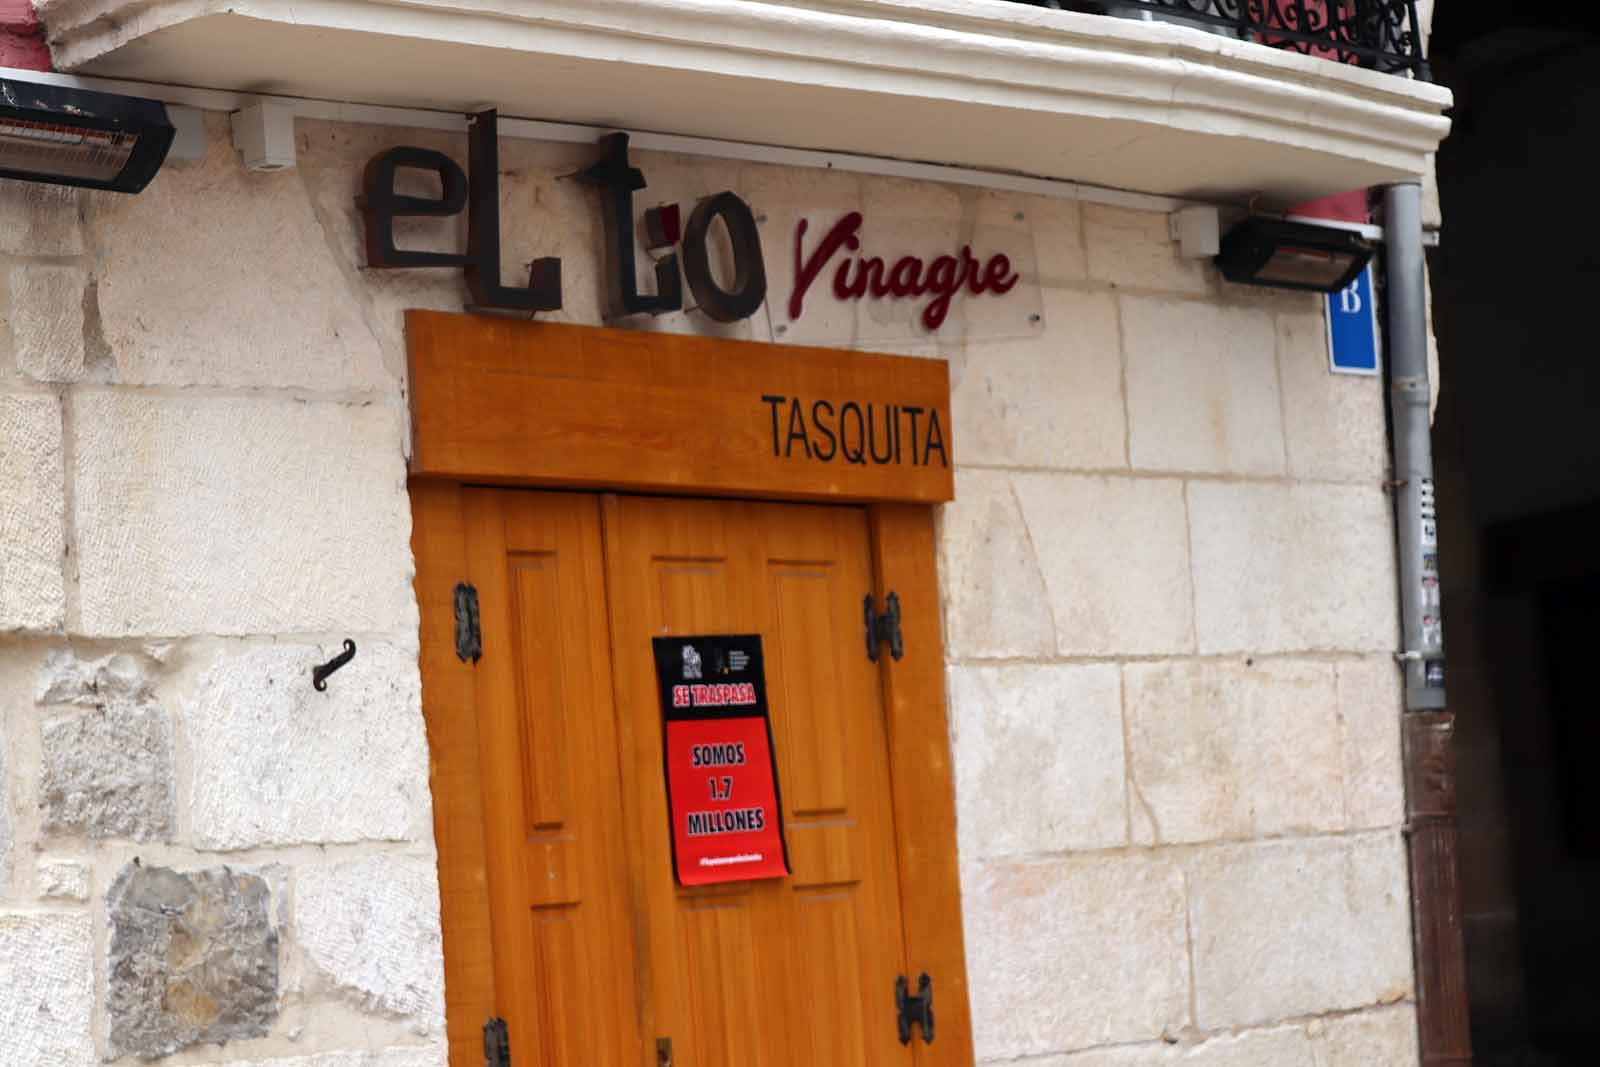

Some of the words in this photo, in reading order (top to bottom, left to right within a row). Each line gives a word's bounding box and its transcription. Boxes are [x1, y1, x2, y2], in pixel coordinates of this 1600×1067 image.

[788, 211, 1019, 331] Vinagre
[761, 395, 948, 468] TASQUITA
[673, 684, 690, 707] SE
[691, 682, 757, 706] TRASPASA
[692, 743, 745, 767] SOMOS
[708, 776, 733, 800] 1.7
[687, 807, 764, 836] MILLONES
